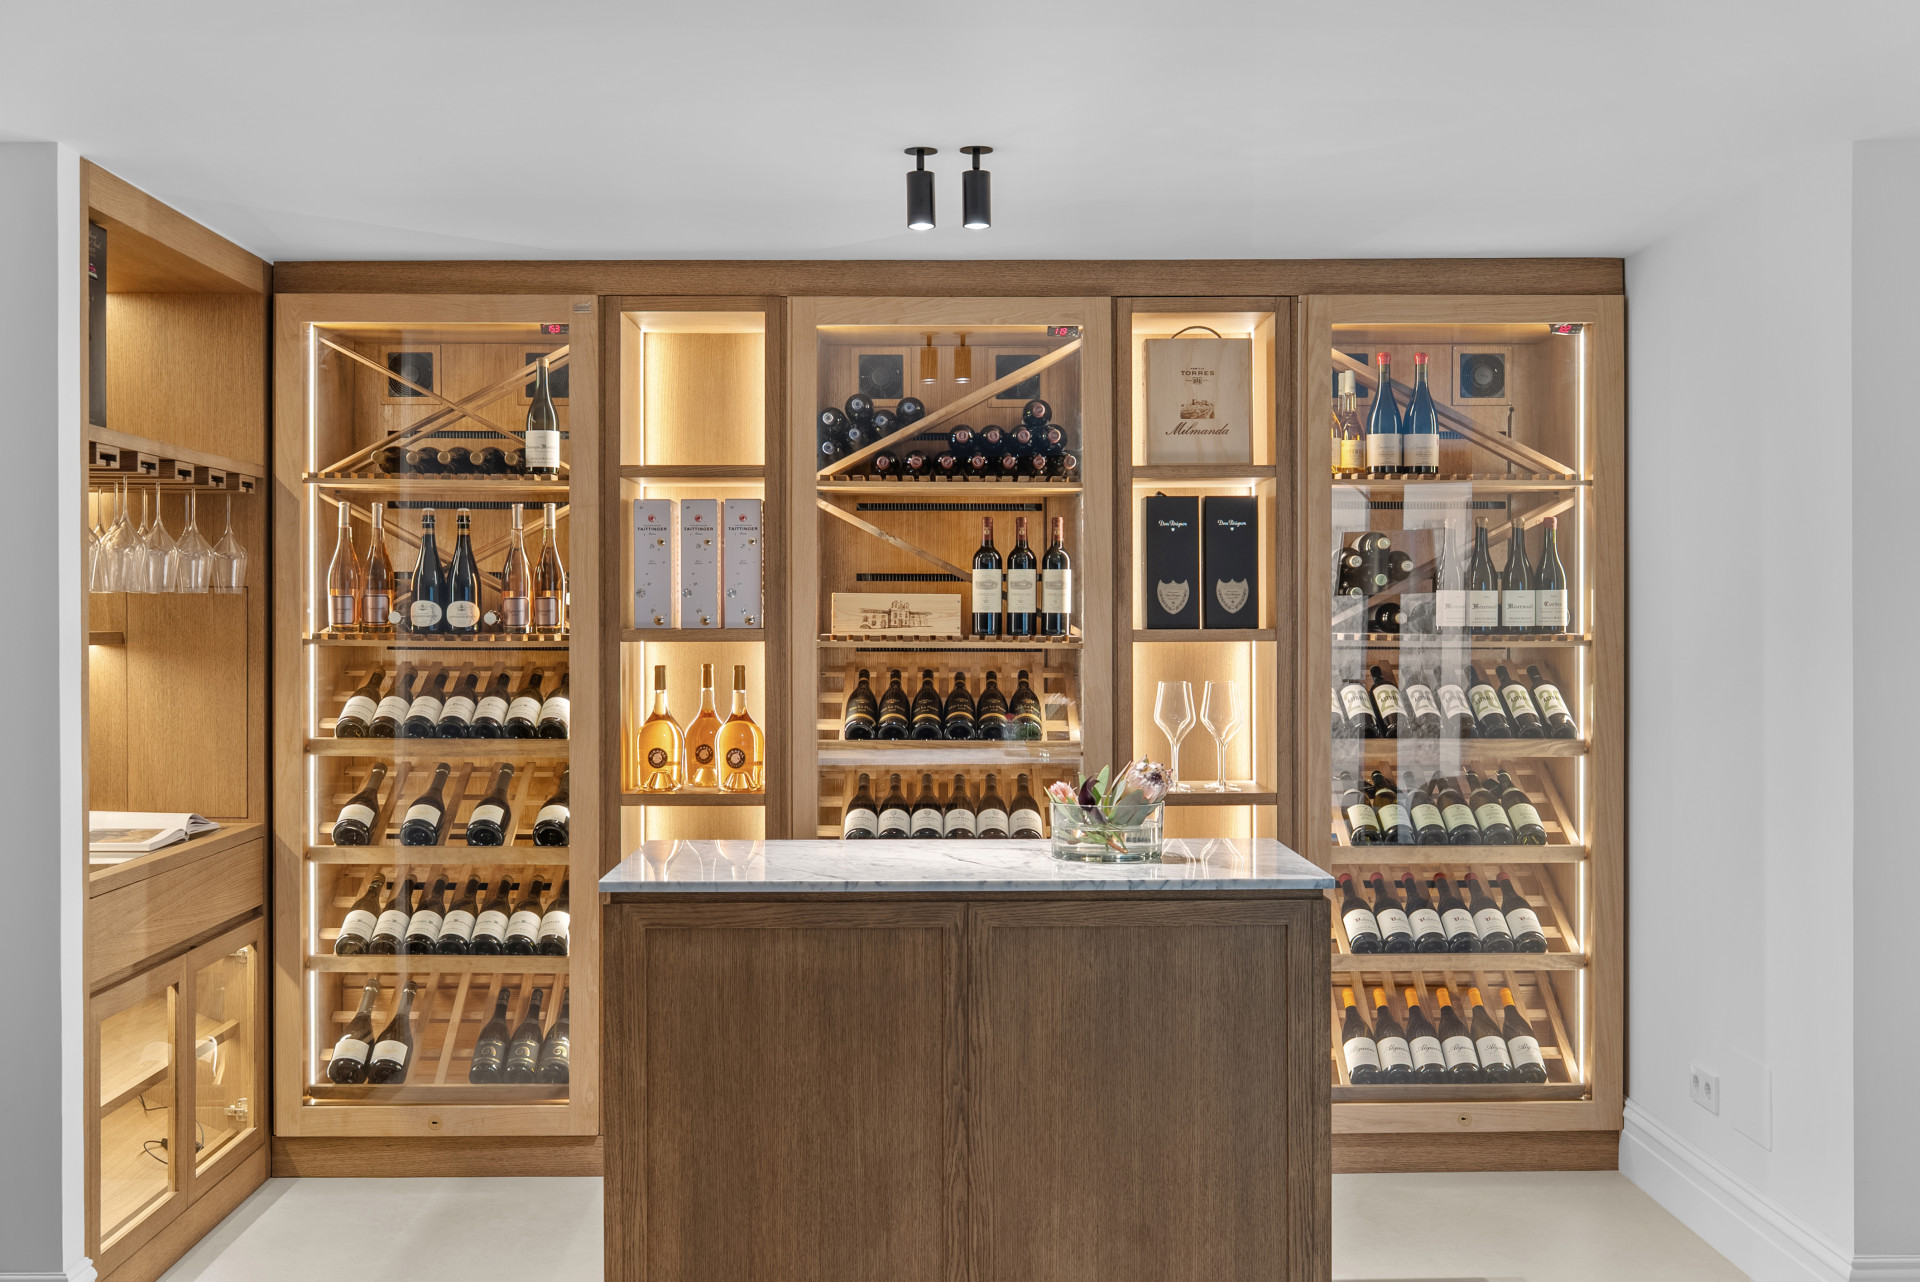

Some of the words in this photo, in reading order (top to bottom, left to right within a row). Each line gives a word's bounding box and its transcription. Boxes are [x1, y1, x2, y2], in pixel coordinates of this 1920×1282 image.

[1165, 421, 1230, 436] Milmanda
[649, 748, 667, 759] MIRAVAL
[696, 745, 713, 755] MIRAVAL
[727, 748, 745, 759] MIRAVAL
